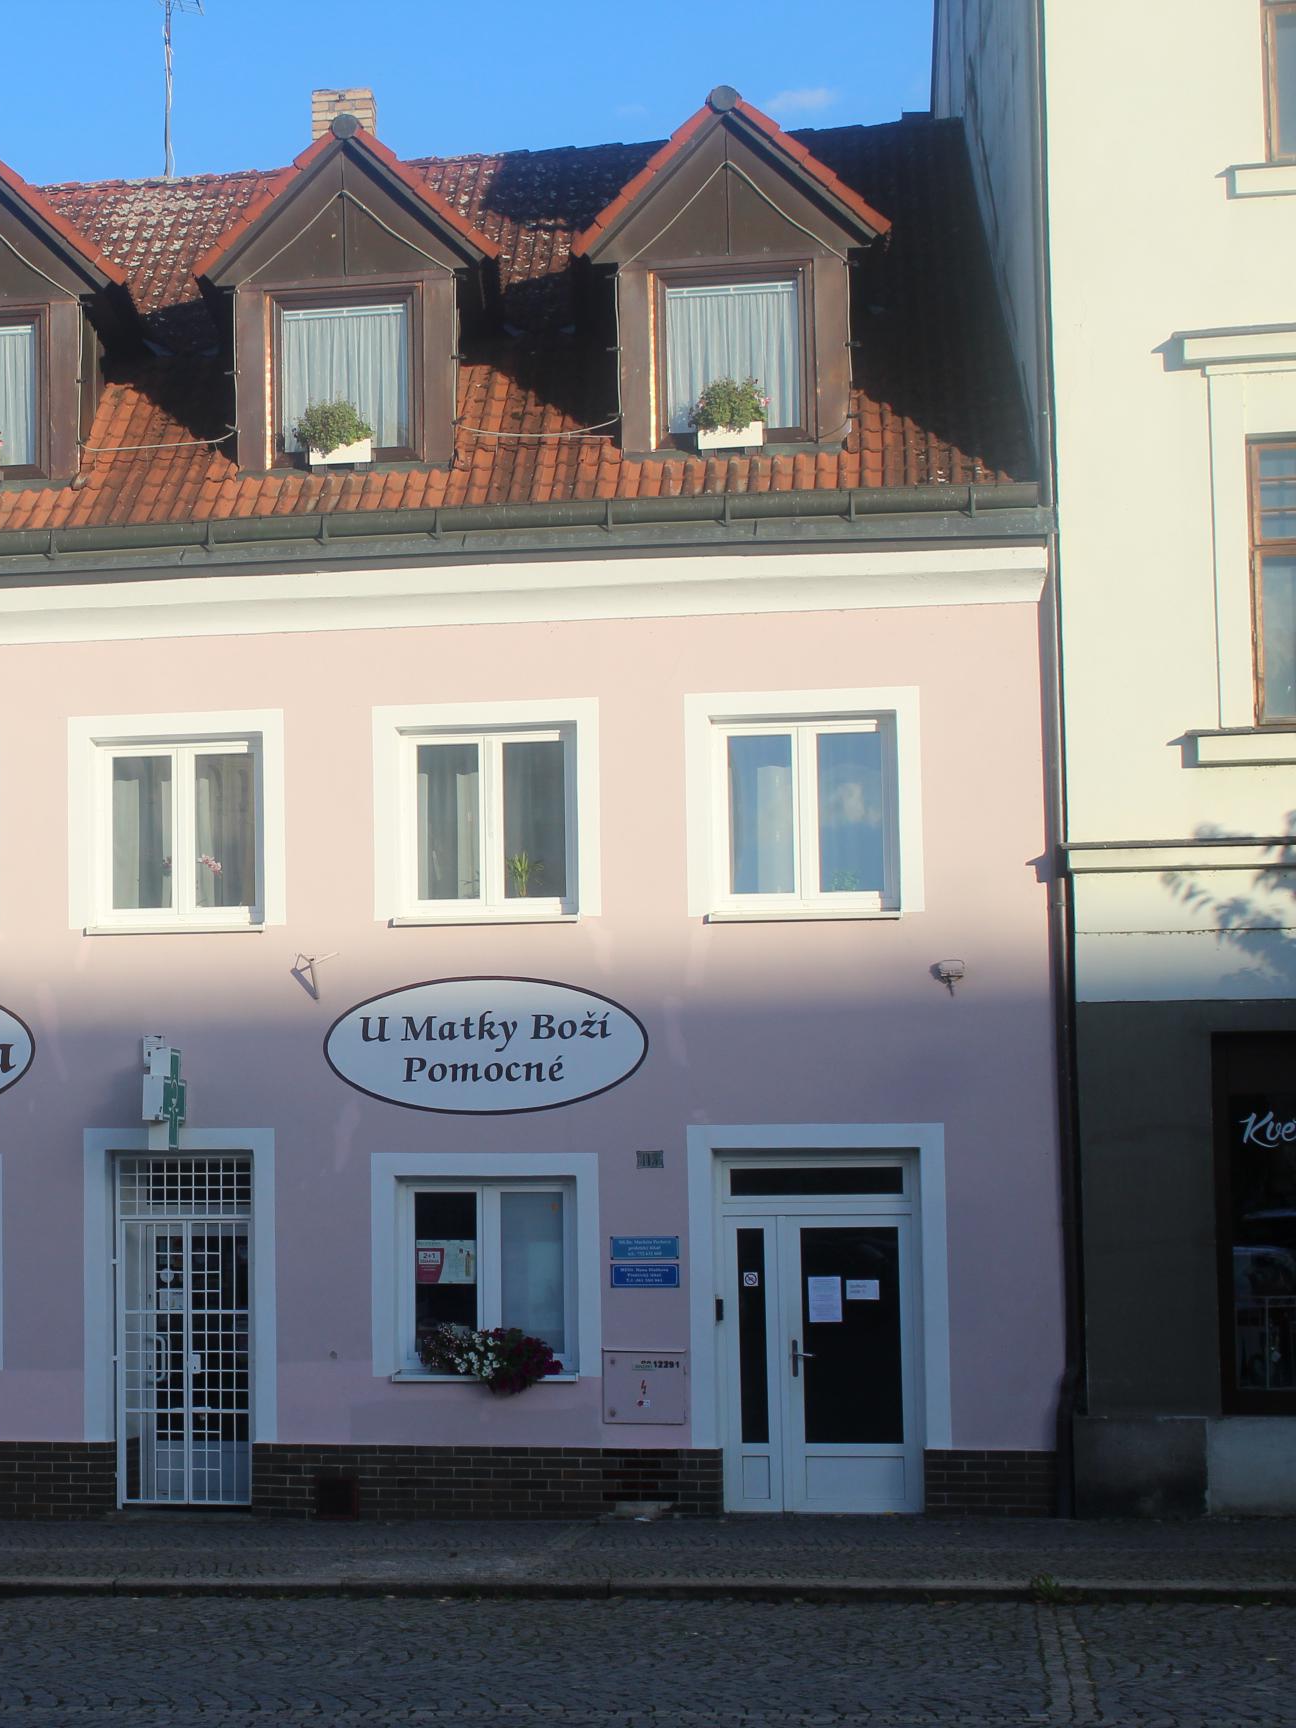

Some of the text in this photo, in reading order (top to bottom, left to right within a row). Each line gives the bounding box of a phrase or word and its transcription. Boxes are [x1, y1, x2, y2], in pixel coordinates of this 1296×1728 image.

[360, 1010, 612, 1053] U Matky Boží
[402, 1055, 565, 1083] Pomocné
